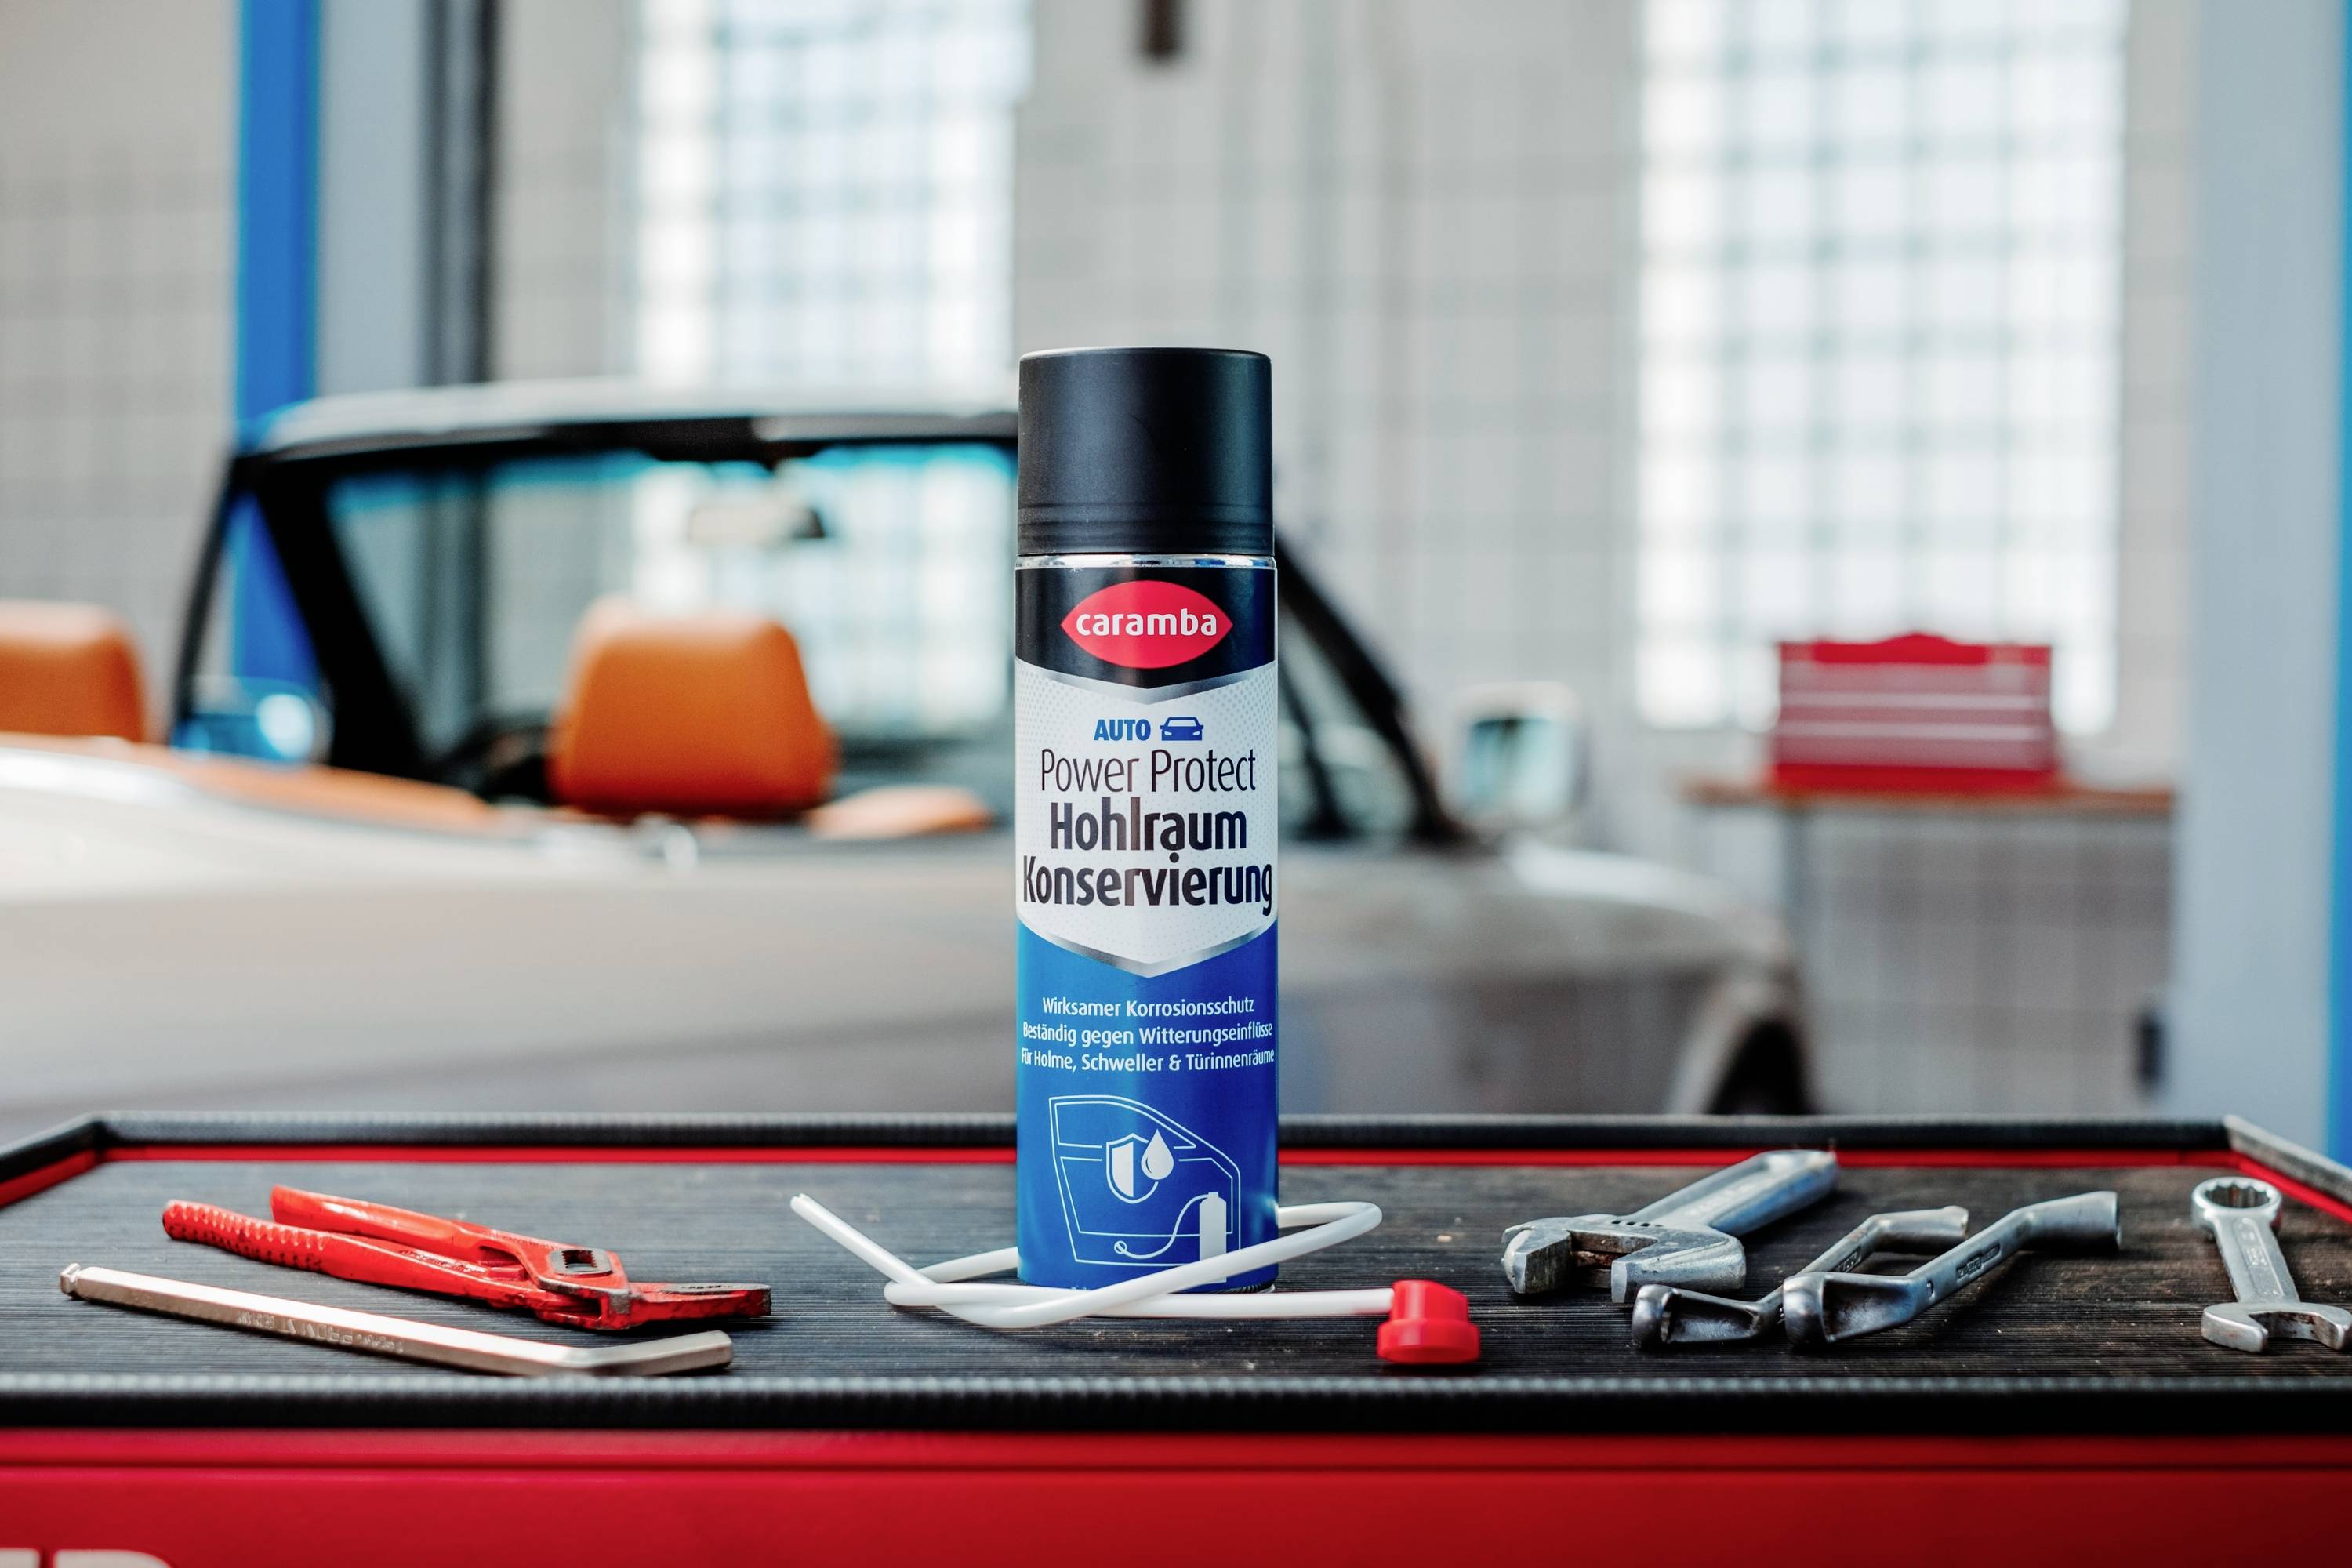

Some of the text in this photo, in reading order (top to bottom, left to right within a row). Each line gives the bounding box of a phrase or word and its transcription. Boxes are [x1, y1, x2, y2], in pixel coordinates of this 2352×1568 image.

[1076, 608, 1217, 637] caramba
[1094, 719, 1151, 741] AUTO
[1041, 749, 1256, 793] Power Protect
[1051, 797, 1247, 851] Hohlraum
[1023, 852, 1272, 916] Konservierung
[1042, 996, 1254, 1017] Wirksamer Korrosionsschutz
[1023, 1022, 1273, 1048] Beständig gegen Witterungseinflüsse
[1022, 1047, 1275, 1073] Für Holme, Schweller & Türinnenräume
